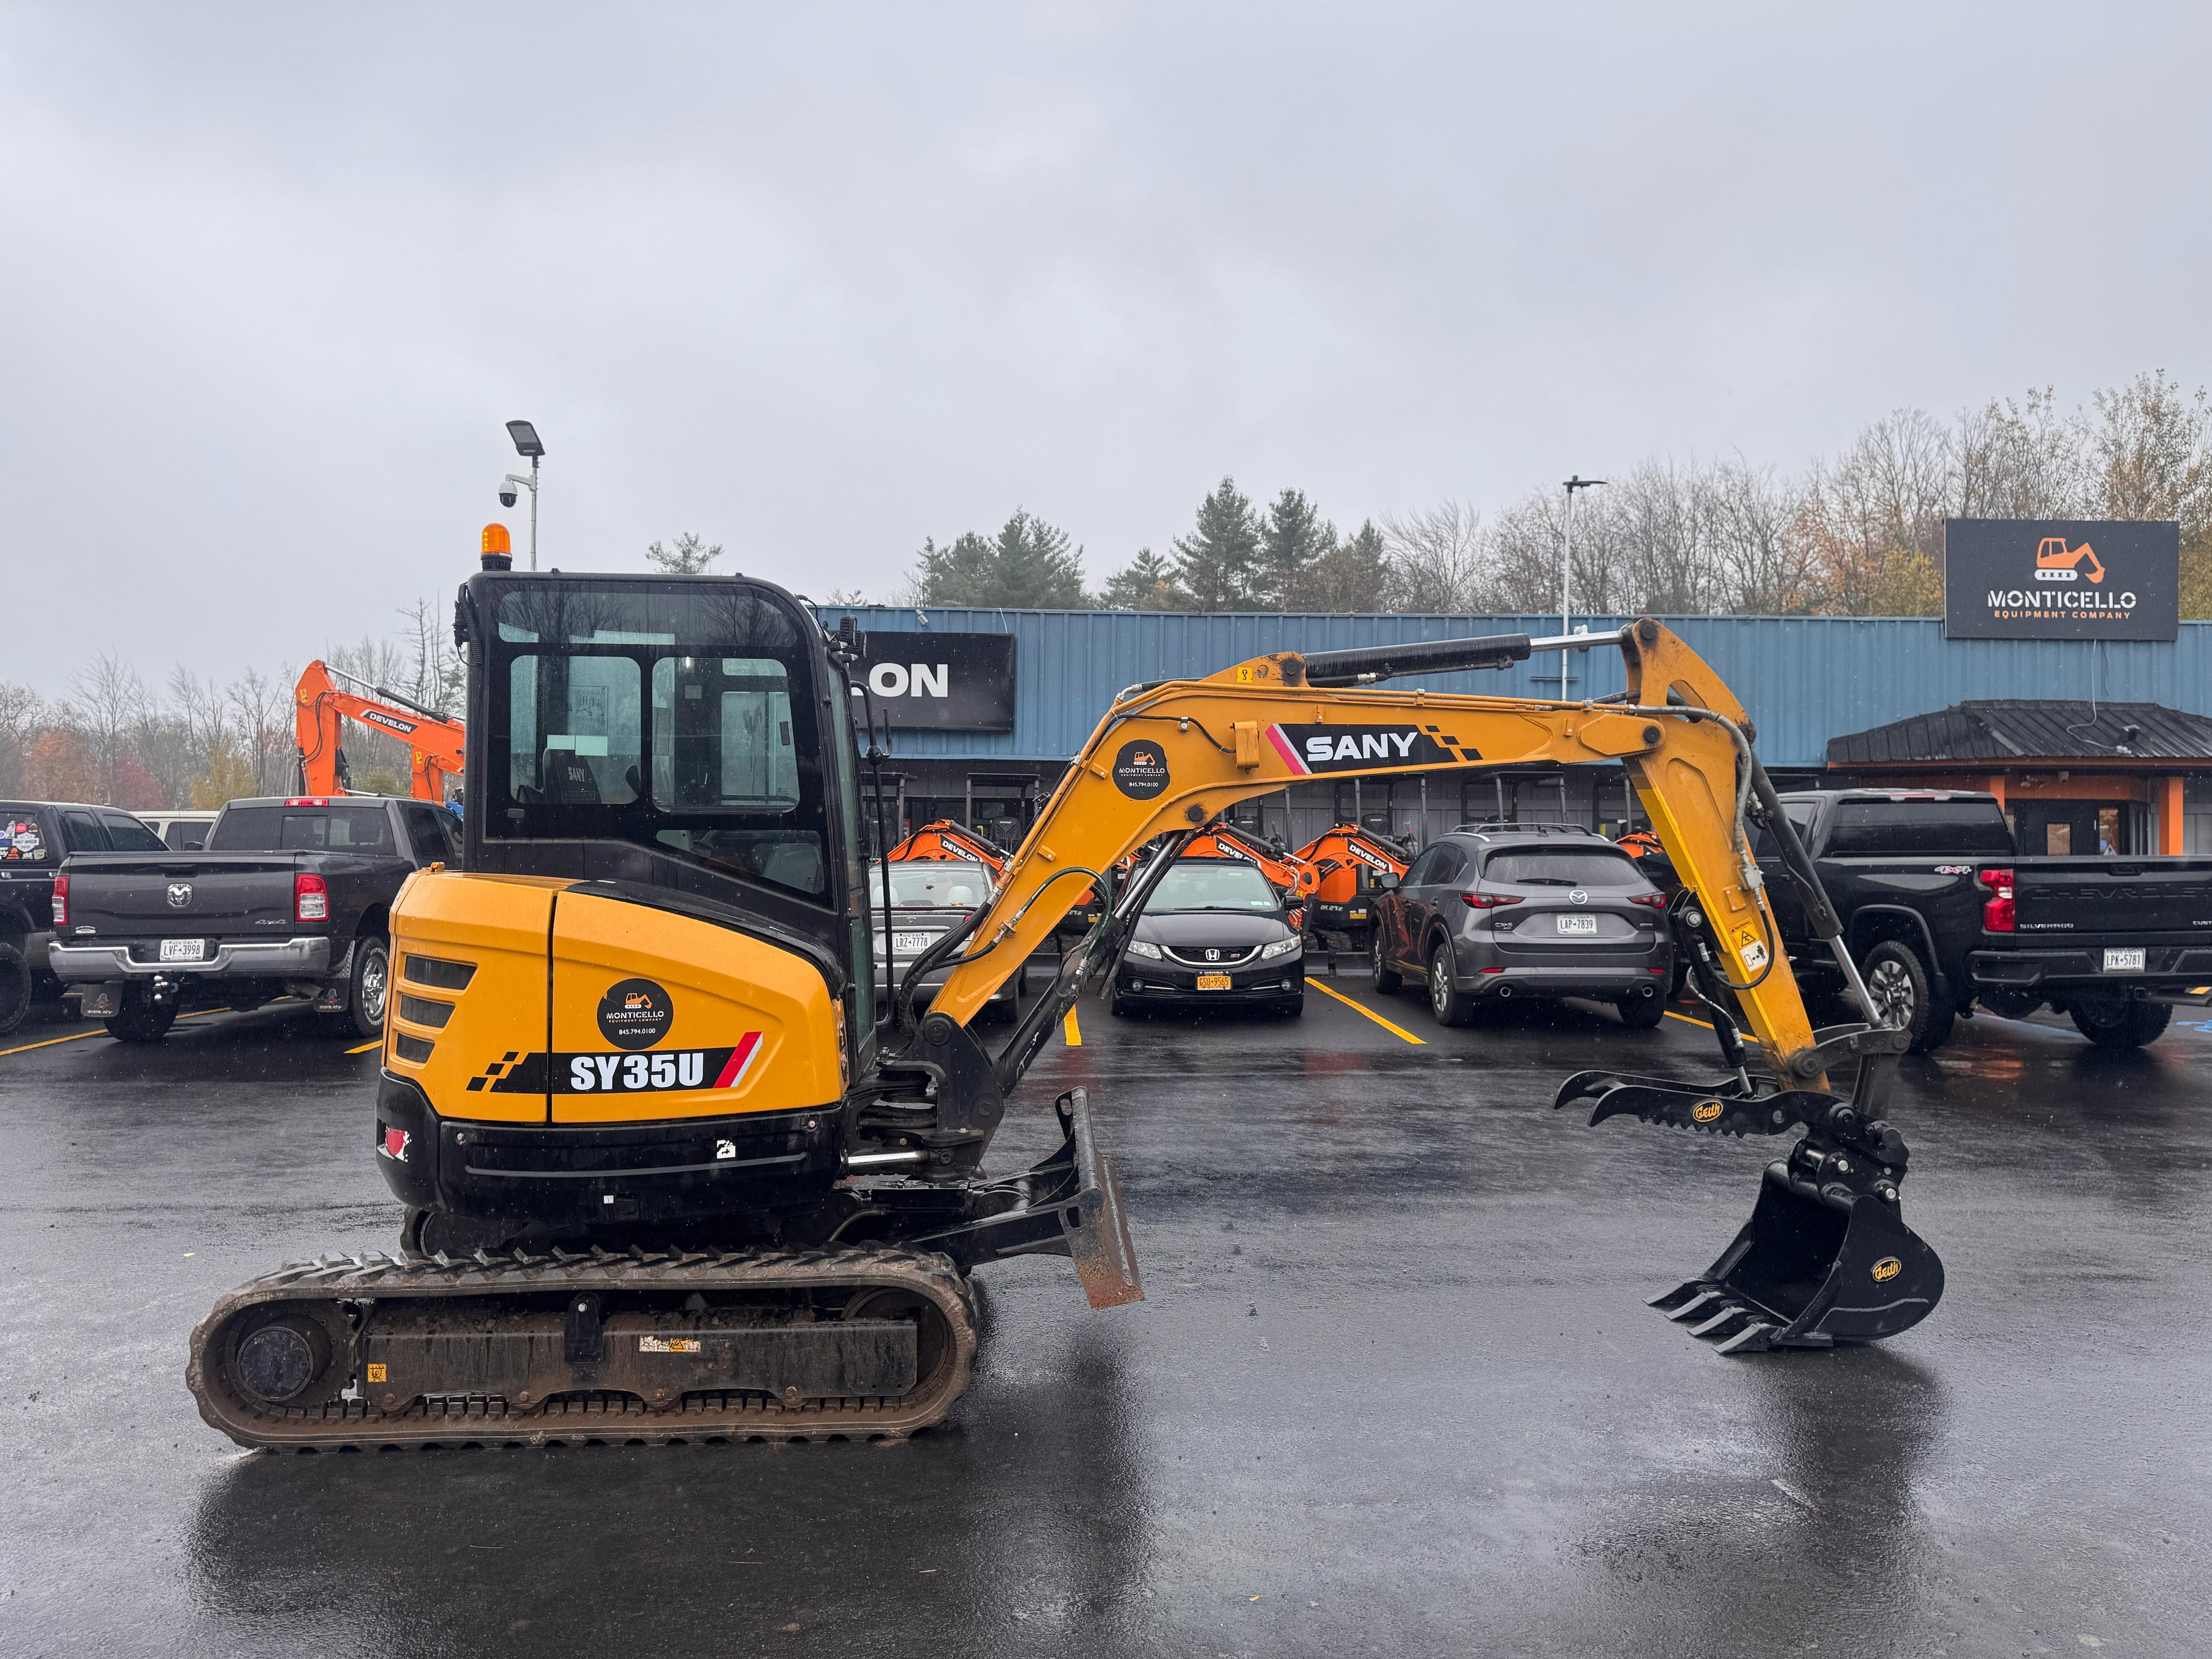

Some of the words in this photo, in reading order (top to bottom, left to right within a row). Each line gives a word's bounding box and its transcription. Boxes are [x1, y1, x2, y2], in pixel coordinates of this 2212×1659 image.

[1988, 590, 2137, 608] MONTICELLO
[1994, 611, 2066, 619] EQUIPMENT
[369, 713, 412, 733] DEVELON
[1306, 732, 1418, 762] SANY
[942, 840, 978, 862] DEVELON
[1218, 843, 1256, 863] DEVE
[1349, 844, 1387, 870] DEVELON
[1560, 919, 1572, 929] LAP
[1577, 919, 1593, 929] 7839
[896, 938, 908, 948] LRZ
[912, 937, 928, 947] 7778
[164, 945, 178, 956] LVF
[182, 945, 200, 955] 3998
[2107, 955, 2119, 966] LPK
[2124, 954, 2140, 965] 5781
[1199, 978, 1210, 986] GSU
[1214, 977, 1229, 986] 9565
[606, 1011, 664, 1019] MONTICELLO
[570, 1052, 704, 1090] SY35U
